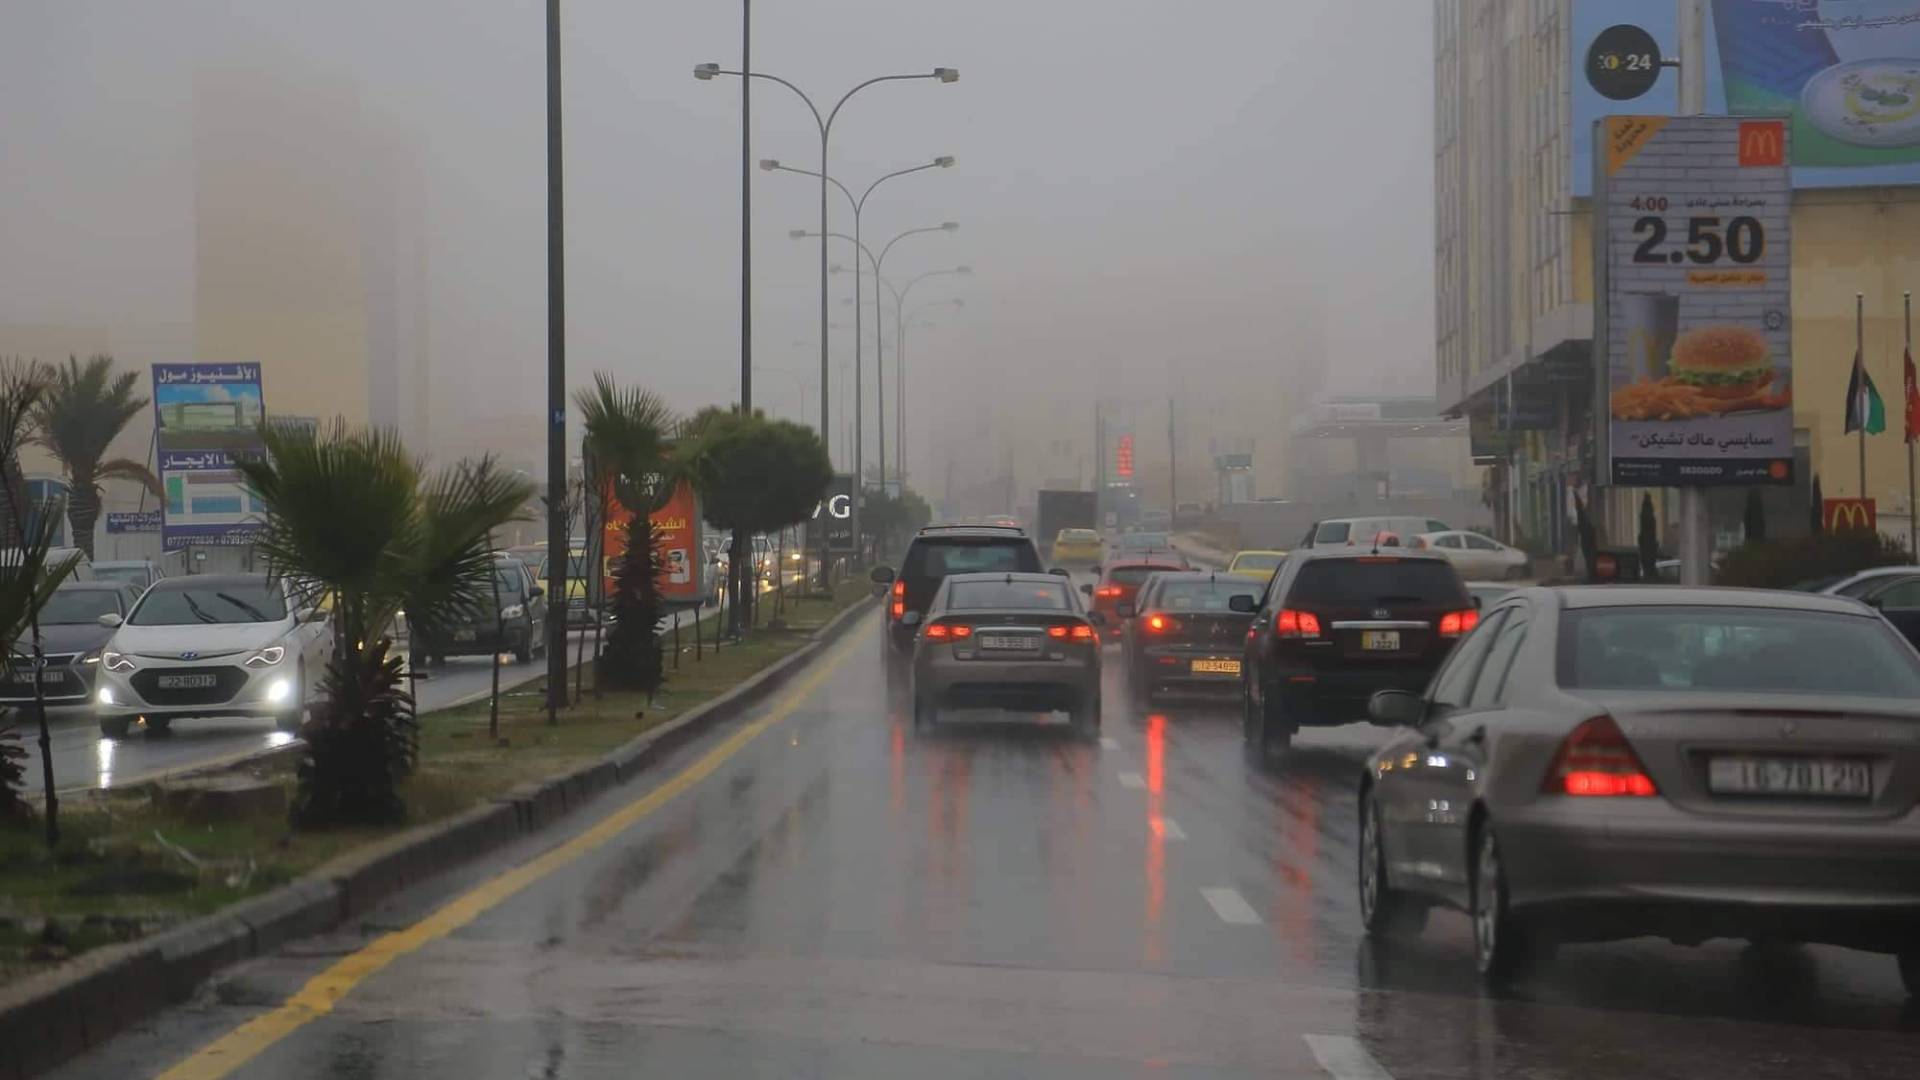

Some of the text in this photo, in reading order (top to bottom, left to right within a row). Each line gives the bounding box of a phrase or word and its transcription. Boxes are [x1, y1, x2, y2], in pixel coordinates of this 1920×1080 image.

[1626, 53, 1652, 71] 24
[1630, 196, 1668, 211] 4.00
[1632, 215, 1764, 264] 2.50
[1638, 432, 1774, 452] سبايسي ماك تشيكن
